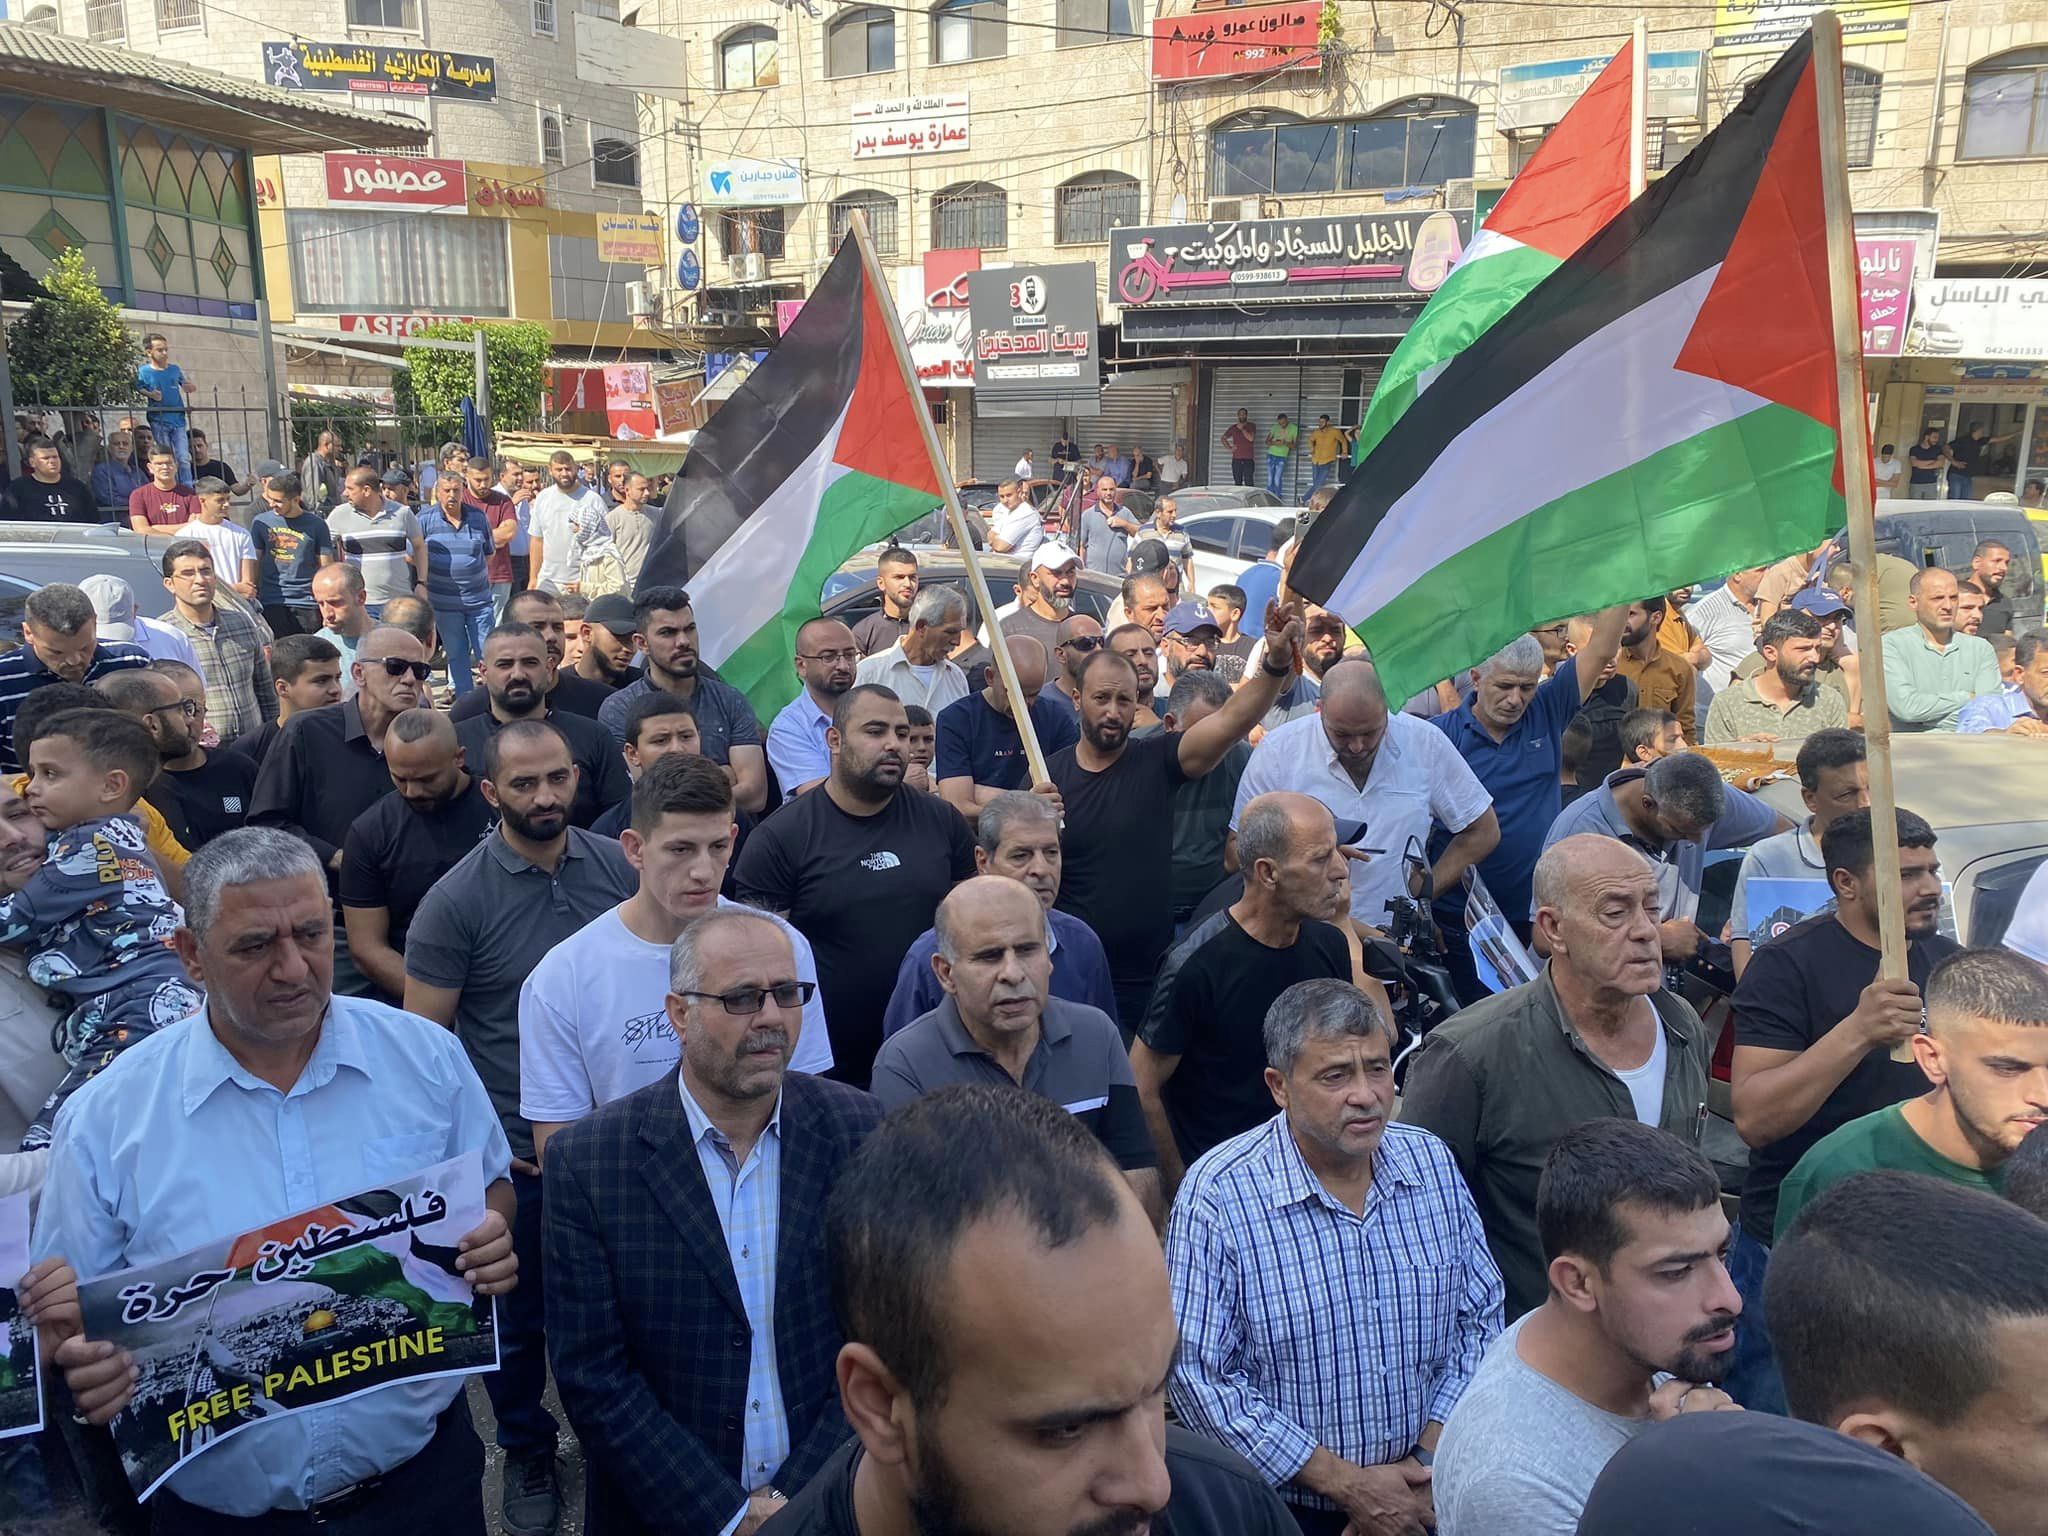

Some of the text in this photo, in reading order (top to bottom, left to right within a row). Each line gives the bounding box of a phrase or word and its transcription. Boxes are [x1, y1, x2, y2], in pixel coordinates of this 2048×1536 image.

[1223, 13, 1306, 37] صالون عمرو
[300, 44, 376, 77] الفلسطينية
[443, 54, 491, 87] مدرسة
[874, 103, 883, 114] لله
[885, 102, 904, 113] الحمد
[906, 105, 911, 113] و
[923, 98, 944, 110] الملك
[854, 123, 967, 156] عمارة يوسف بدر
[344, 159, 447, 194] عصفور
[740, 168, 797, 183] هلال جبارين
[1180, 220, 1414, 265] الخليل للسجاد والموكيت
[1860, 248, 1901, 276] نايلو
[1236, 271, 1281, 281] 0599-938613
[1931, 285, 2009, 308] الباسل
[1870, 305, 1899, 321] جملة
[976, 325, 1089, 360] بيت المدخنين
[118, 1188, 448, 1325] فلسطين حرة
[167, 1325, 446, 1442] FREE PALESTINE
